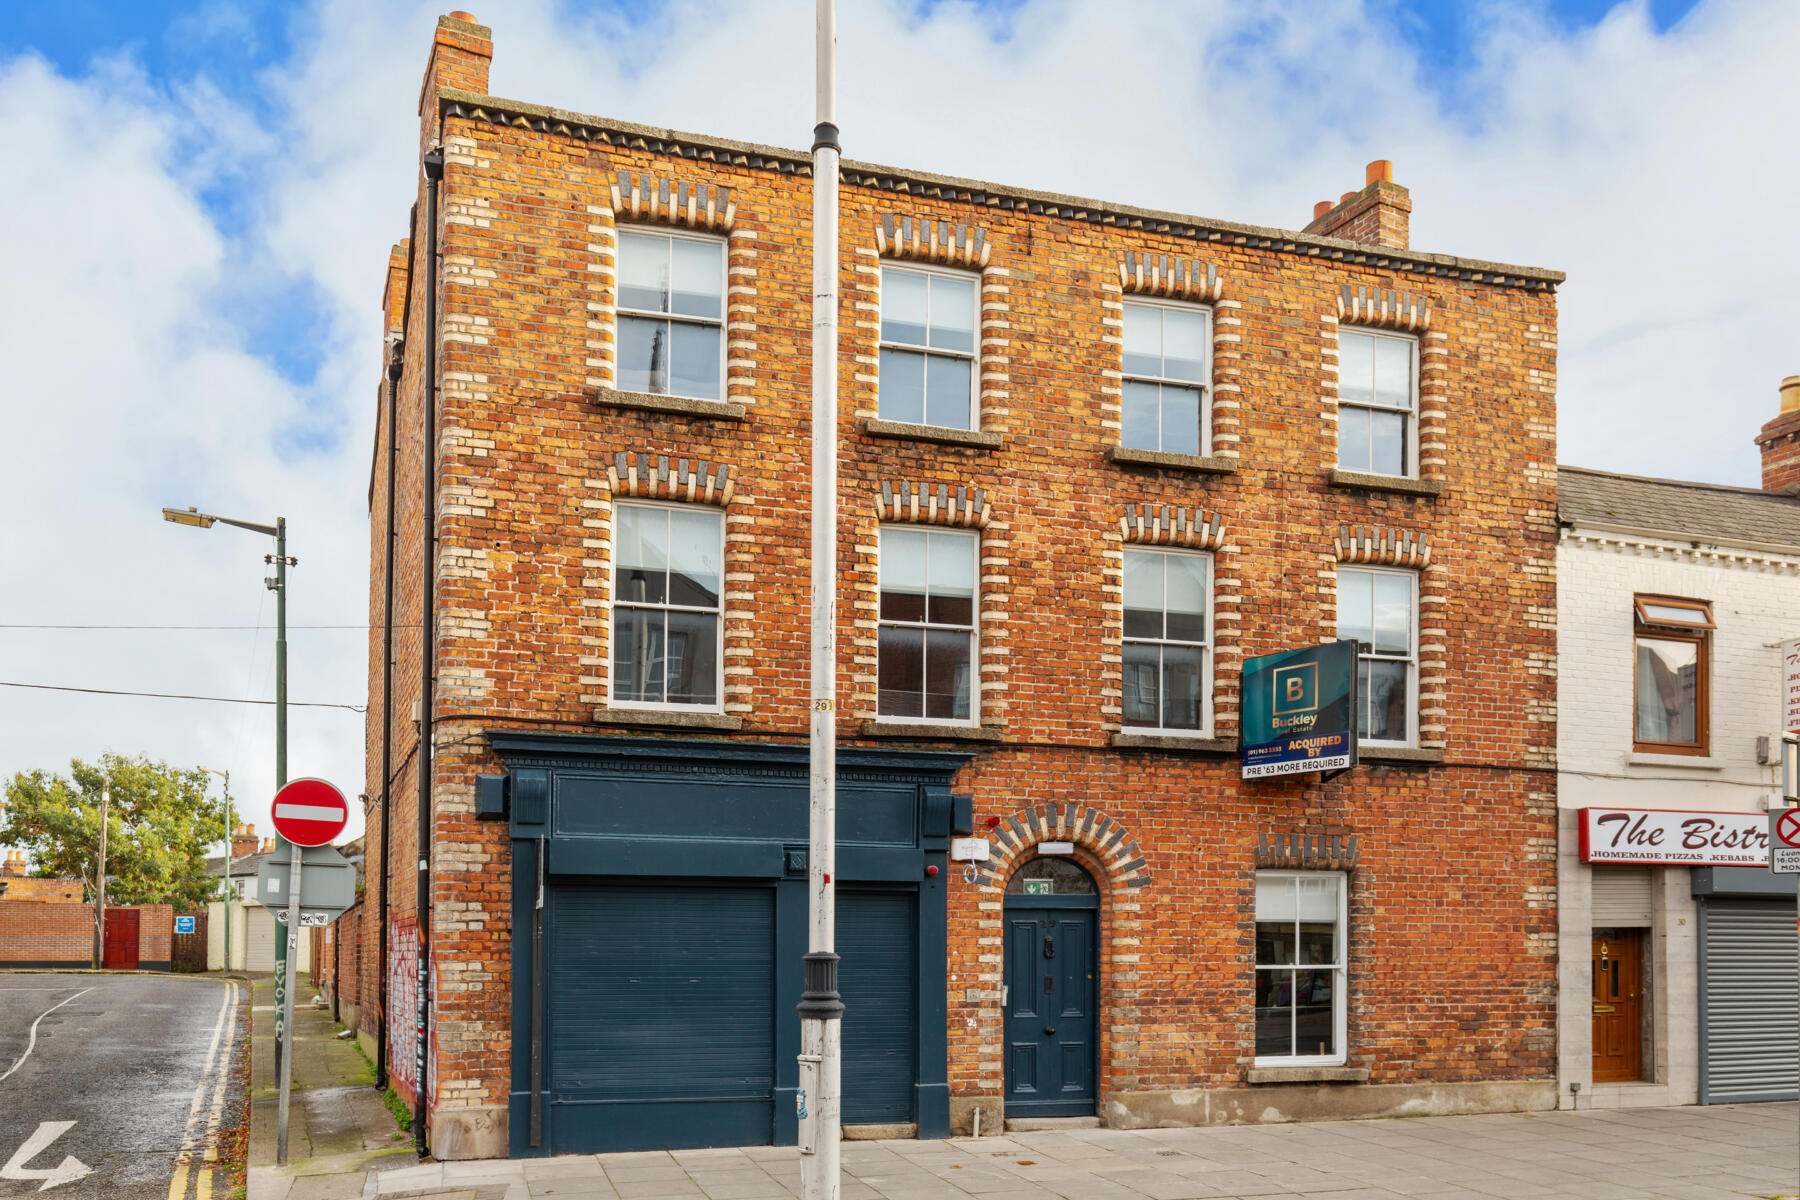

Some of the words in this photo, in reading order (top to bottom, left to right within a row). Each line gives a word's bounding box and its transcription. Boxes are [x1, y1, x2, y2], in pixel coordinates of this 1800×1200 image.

[1286, 677, 1304, 702] B
[1272, 714, 1318, 729] Buckley
[1288, 735, 1342, 751] ACQUIRED
[1307, 747, 1322, 758] BY
[1247, 766, 1262, 775] PRE
[1263, 765, 1275, 774] '63
[1277, 762, 1300, 773] MORE
[1302, 757, 1345, 770] REQUIRED
[1597, 813, 1665, 848] The
[1665, 852, 1704, 861] PIZZAS
